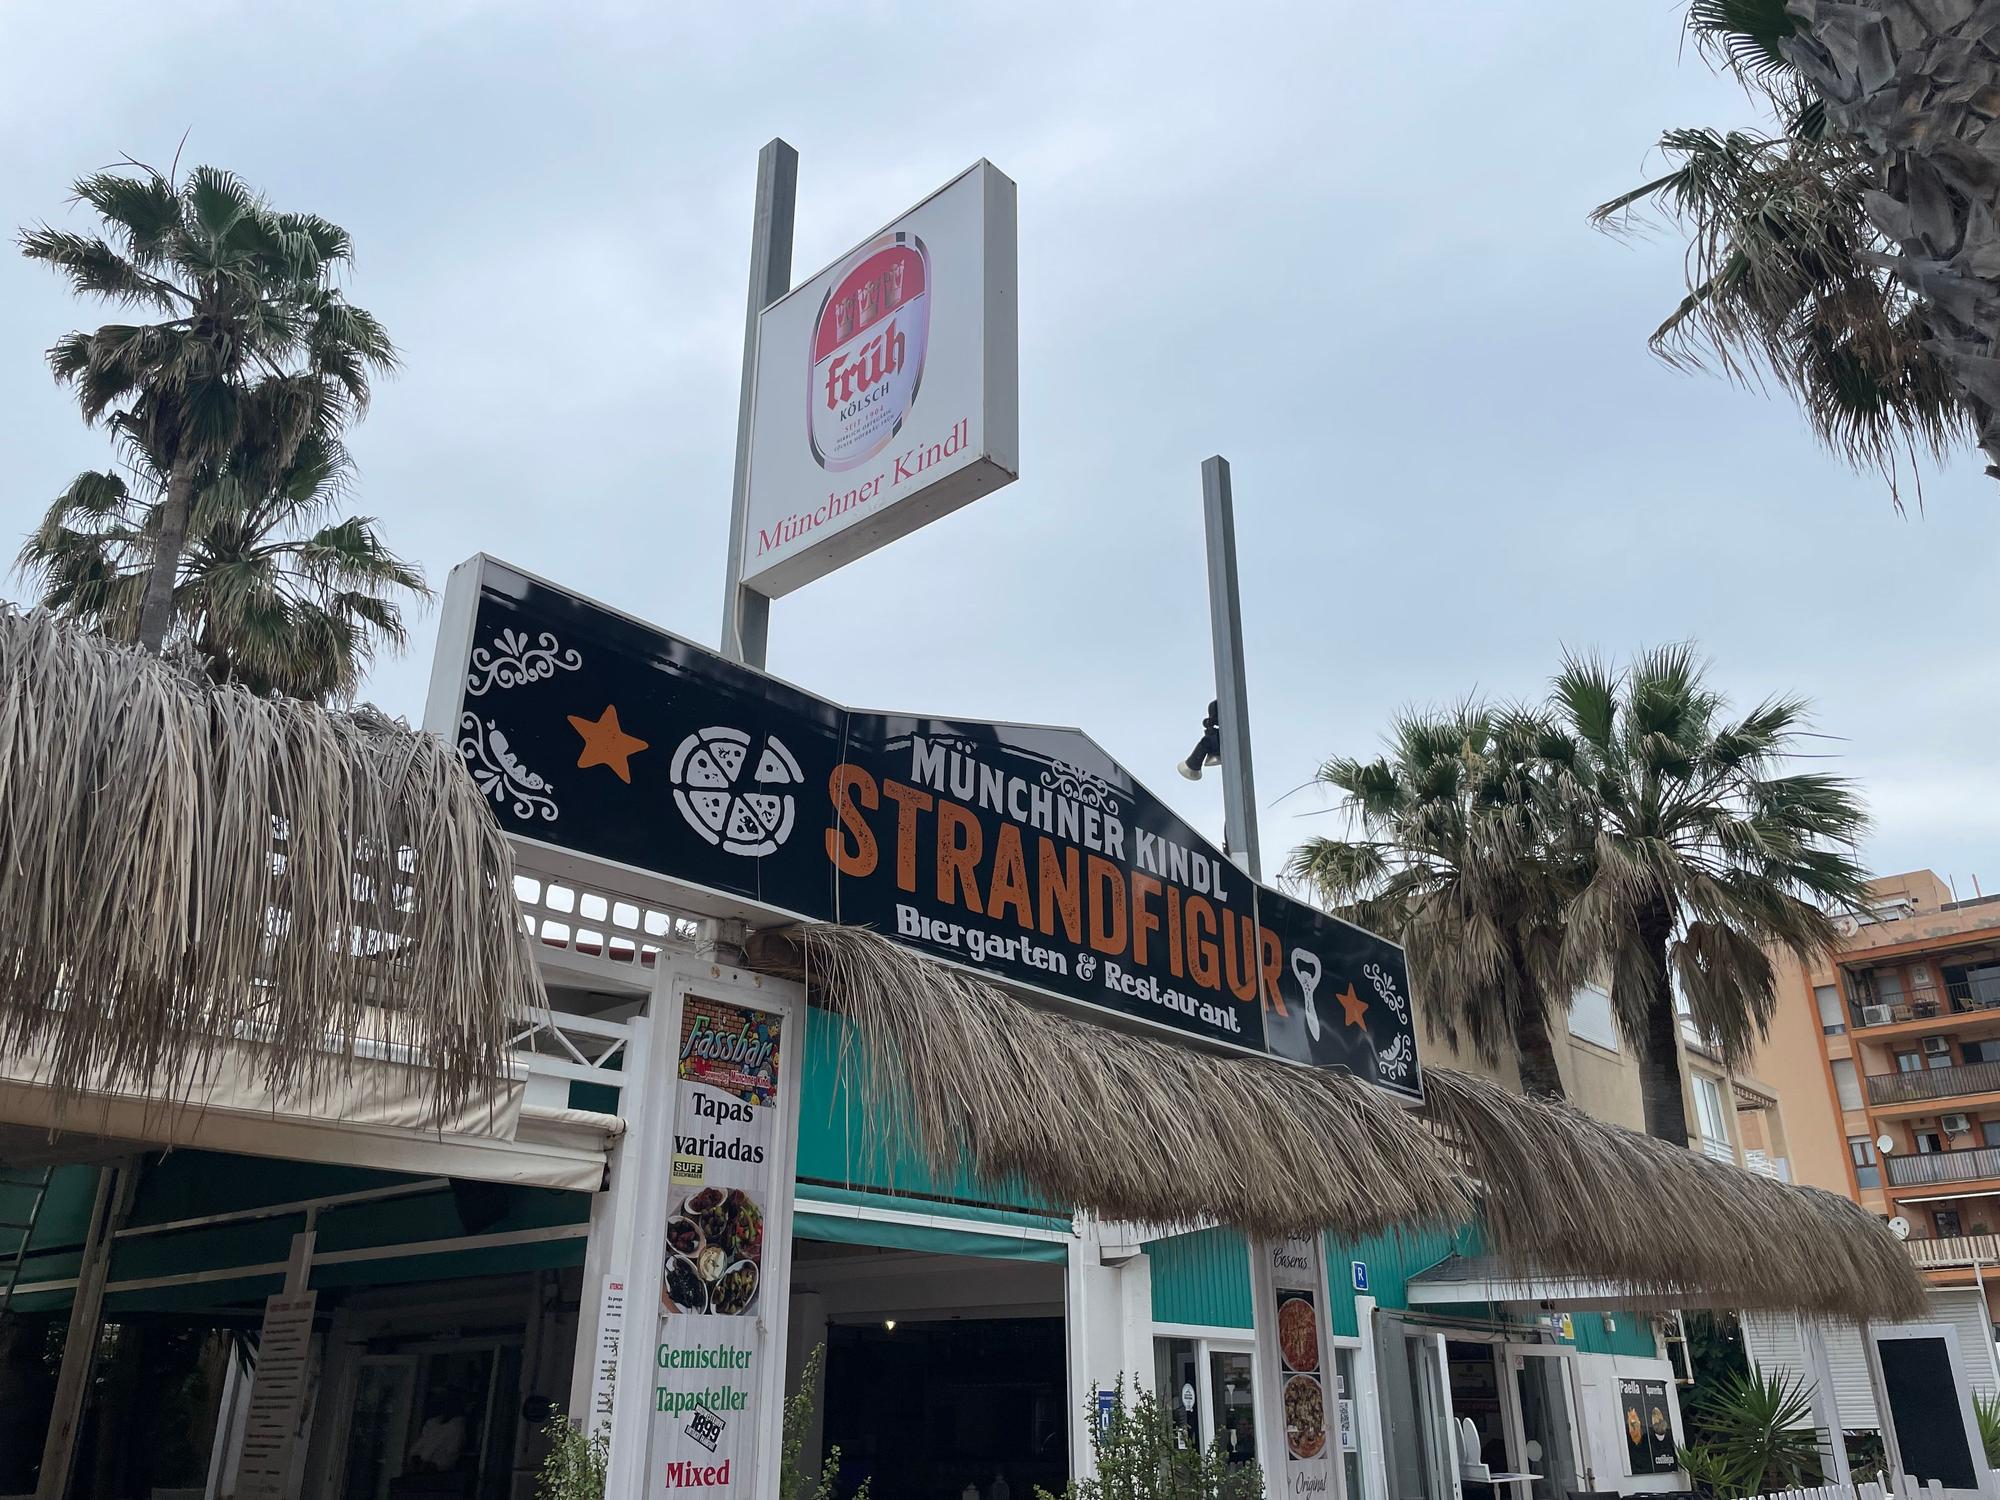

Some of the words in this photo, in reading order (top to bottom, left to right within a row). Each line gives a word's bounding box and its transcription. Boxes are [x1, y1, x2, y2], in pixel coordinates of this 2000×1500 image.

[825, 318, 906, 411] früh
[840, 382, 889, 423] KÖLSCH
[756, 473, 885, 557] Münchner
[892, 417, 969, 487] Kindl
[910, 733, 1126, 862] MÜNCHNER
[1135, 825, 1229, 902] KINDL
[824, 763, 1289, 1018] STRANDFIGUR
[895, 903, 1068, 976] Biergarten
[1075, 952, 1097, 982] &
[1104, 961, 1242, 1034] Restaurant
[680, 1014, 774, 1068] Fassbar
[692, 1092, 754, 1125] Tapas
[674, 1133, 764, 1164] variadas
[675, 1162, 702, 1173] SUFF
[1273, 1247, 1308, 1271] Caseras
[1357, 1267, 1364, 1281] R
[657, 1344, 752, 1369] Gemischter
[656, 1386, 749, 1418] Tapasteller
[1619, 1380, 1640, 1395] Paella
[691, 1412, 721, 1443] 1899
[665, 1459, 730, 1488] Mixed
[1296, 1471, 1327, 1500] Original
